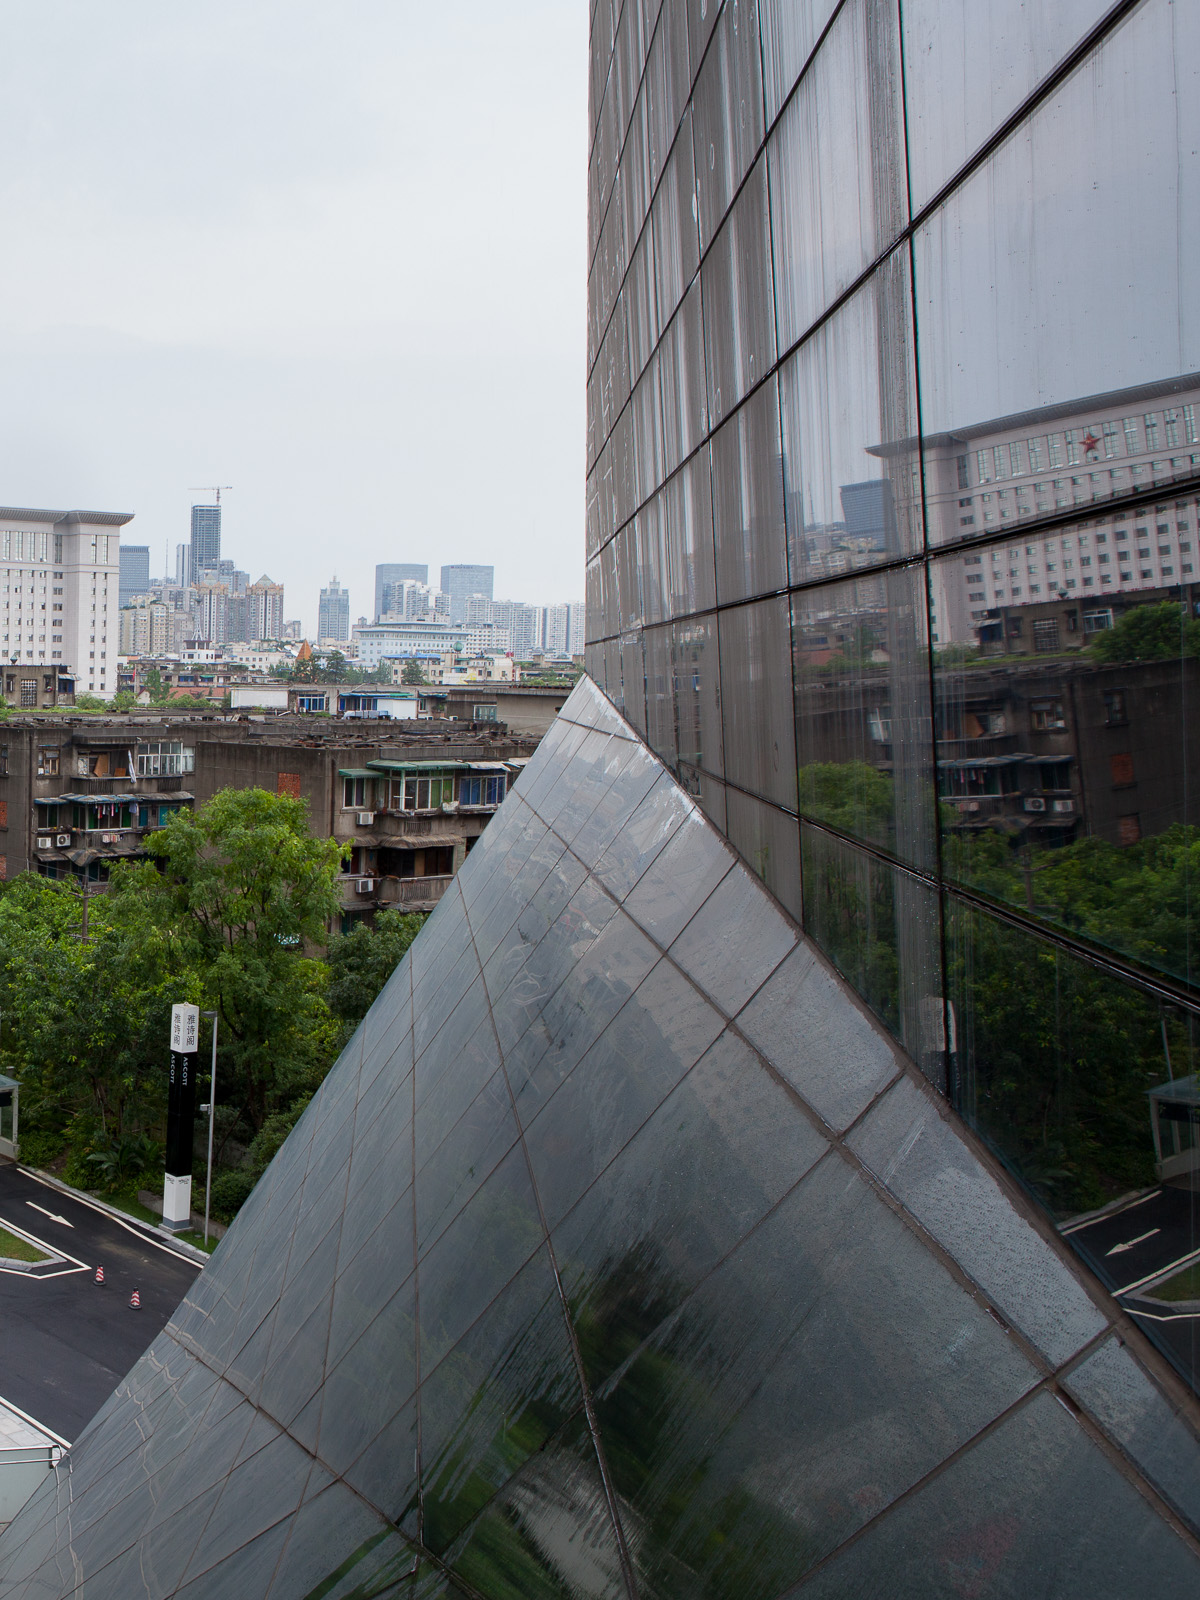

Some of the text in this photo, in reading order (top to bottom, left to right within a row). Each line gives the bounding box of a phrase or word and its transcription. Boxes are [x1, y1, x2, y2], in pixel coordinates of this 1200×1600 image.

[173, 1013, 181, 1046] 雅诗阁
[186, 1014, 196, 1046] 雅诗阁
